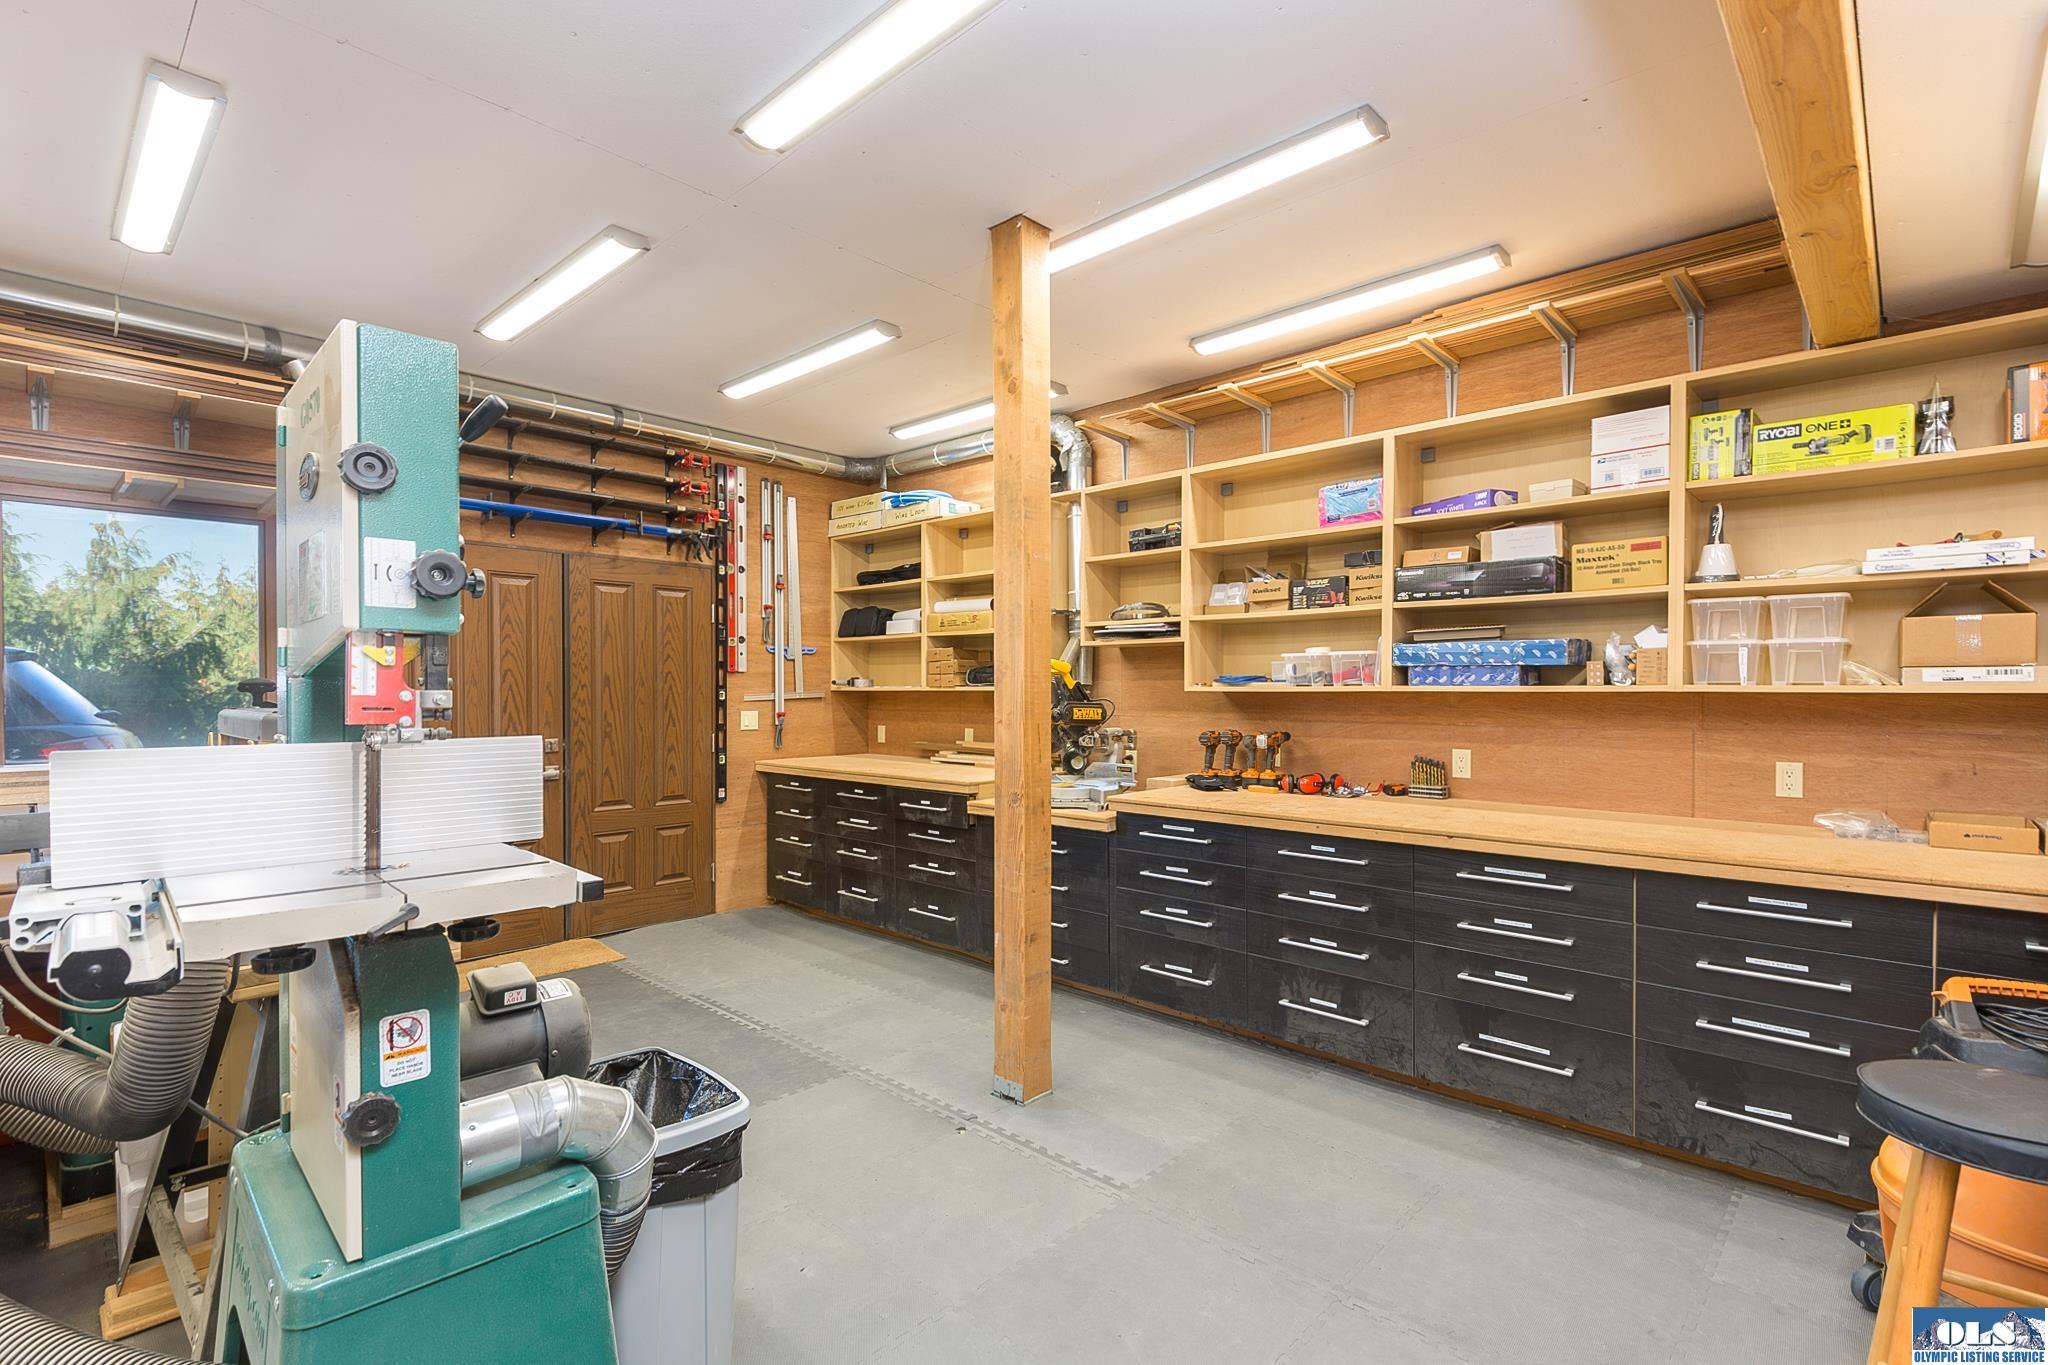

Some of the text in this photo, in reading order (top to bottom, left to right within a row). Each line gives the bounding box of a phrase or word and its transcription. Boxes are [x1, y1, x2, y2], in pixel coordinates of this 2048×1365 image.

[1759, 426, 1801, 440] RYOBI
[1576, 554, 1615, 564] Maxtek
[1252, 586, 1281, 595] Kwikset
[389, 1065, 405, 1073] PLACE
